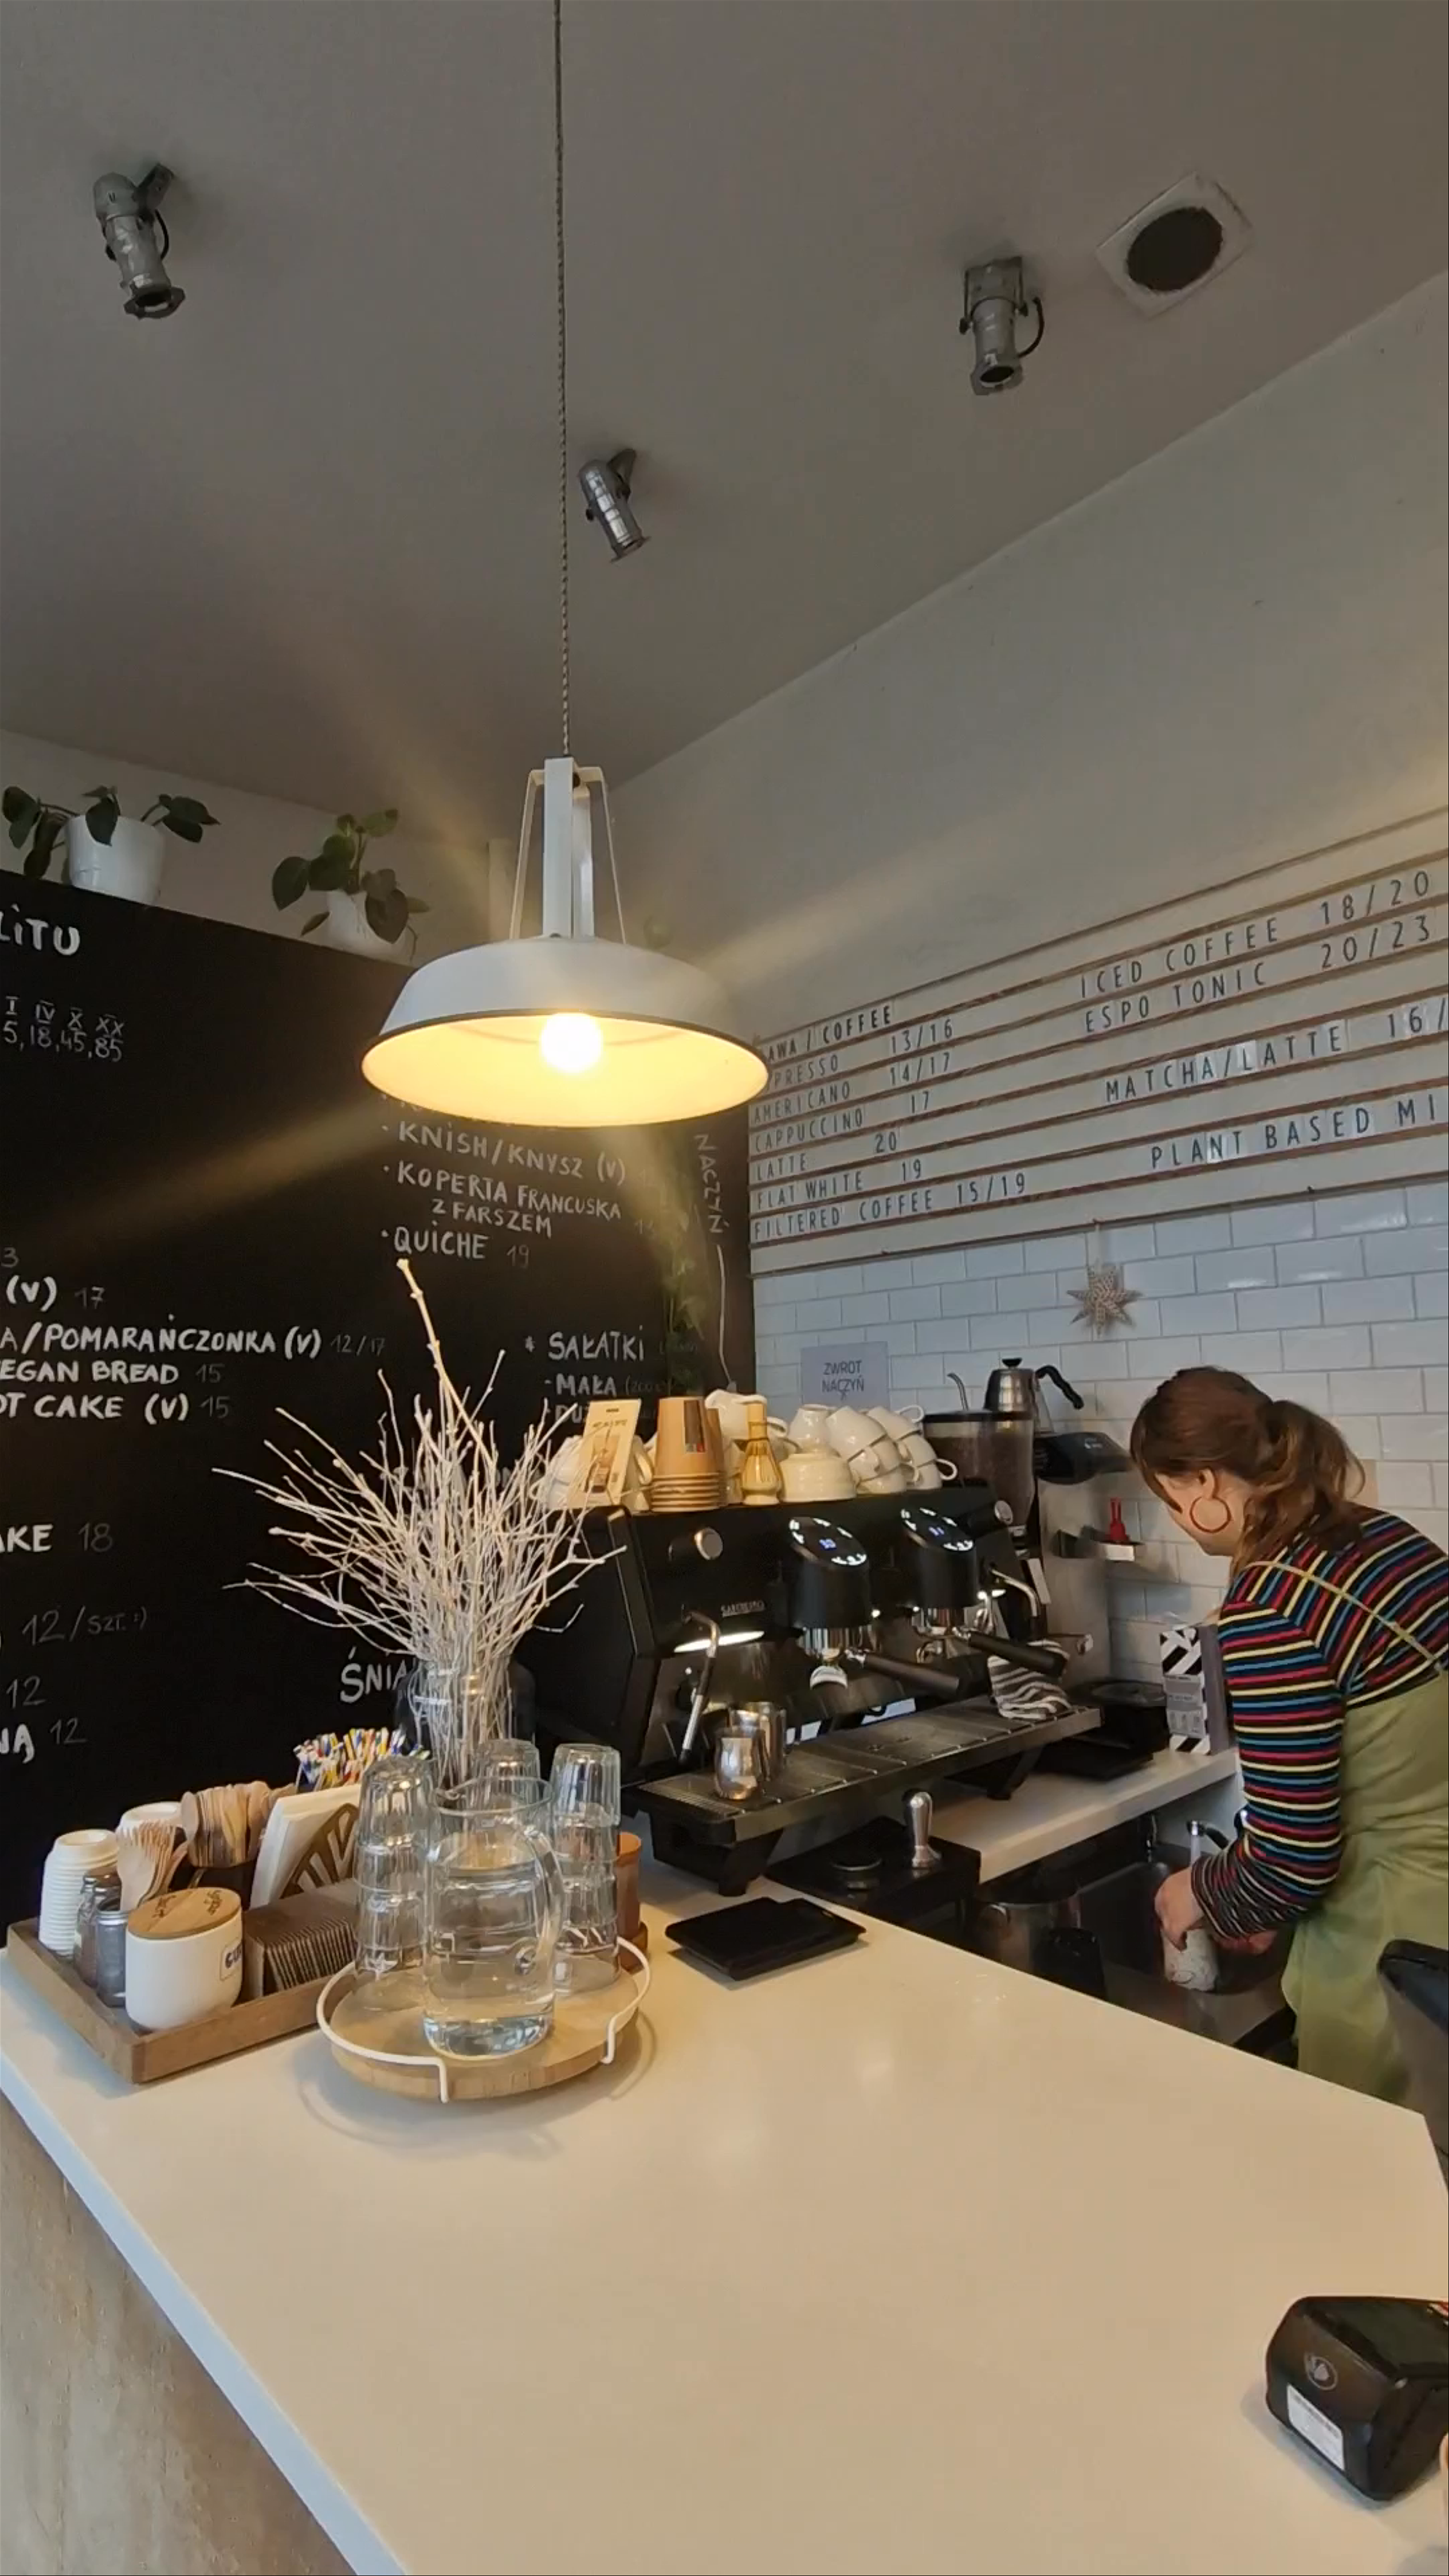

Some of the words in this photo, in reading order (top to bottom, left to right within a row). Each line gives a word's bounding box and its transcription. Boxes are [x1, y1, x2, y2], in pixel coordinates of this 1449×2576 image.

[1081, 961, 1142, 998] ICED
[1166, 917, 1277, 971] COFFEE
[1321, 870, 1429, 925] 18/20
[1086, 996, 1149, 1033] ESPO
[1174, 963, 1266, 1007] TONIC
[1321, 915, 1430, 969] 20/23
[823, 1005, 891, 1044] COFFEE
[769, 1055, 838, 1091] PRESSO
[891, 1019, 952, 1053] 13/16
[1106, 1026, 1341, 1103] MATCHA/LATTE
[754, 1081, 850, 1124] AMERICANO
[890, 1053, 950, 1086] 14/17
[755, 1108, 863, 1152] CAPPUCCINO
[911, 1091, 929, 1113] 17
[1152, 1131, 1243, 1169] PLANT
[1266, 1108, 1370, 1149] BASED
[757, 1153, 807, 1181] LATTE
[875, 1133, 897, 1153] 20
[398, 1160, 508, 1203] KOPERTA
[518, 1185, 621, 1221] FRANCUSKA
[758, 1186, 795, 1209] FLAT
[806, 1171, 863, 1199] WHITE
[902, 1159, 921, 1181] 19
[453, 1202, 552, 1239] FARSZEM
[755, 1207, 840, 1240] FILTERED
[860, 1189, 932, 1222] COFFEE
[957, 1173, 1025, 1205] 15/19
[506, 1244, 530, 1268] 19
[74, 1286, 105, 1309] 17
[331, 1335, 385, 1356] 12/17
[92, 1360, 178, 1385] BREAD
[195, 1363, 225, 1384] 15
[556, 1373, 617, 1397] MAŁA
[822, 1375, 864, 1393] NACZYŃ
[823, 1360, 862, 1375] ZWROT
[34, 1395, 123, 1420] CAKE
[200, 1395, 230, 1419] 15
[78, 1522, 113, 1552] 18
[6, 1676, 46, 1709] 12
[50, 1717, 88, 1745] 12
